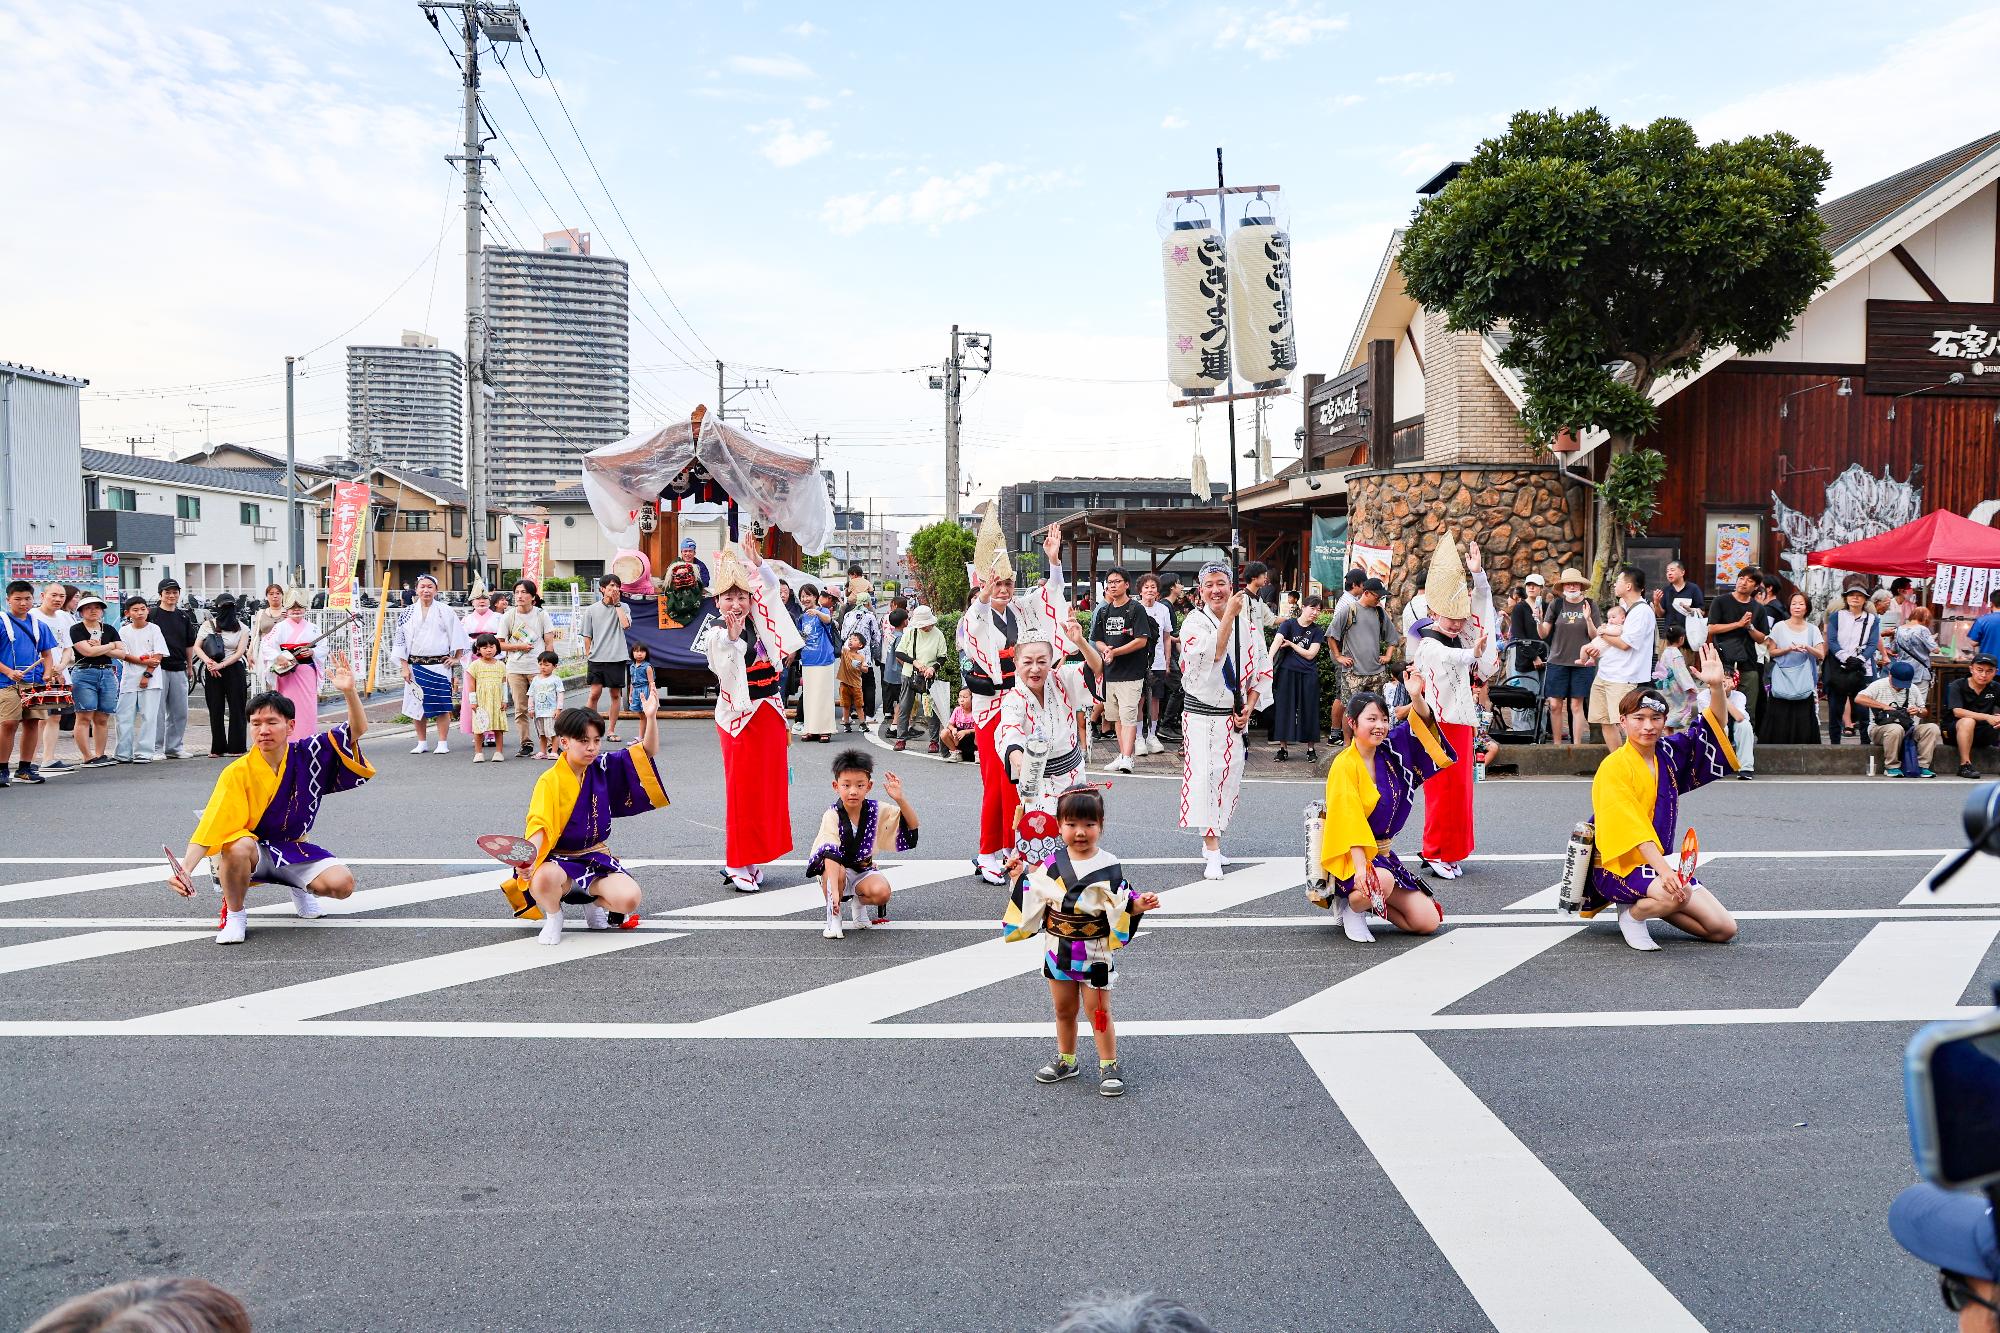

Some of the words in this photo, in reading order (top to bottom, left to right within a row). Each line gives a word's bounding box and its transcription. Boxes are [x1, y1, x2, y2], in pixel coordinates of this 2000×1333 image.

[1319, 385, 1359, 426] 石窯パン工房
[332, 501, 357, 593] キャンペーン
[527, 538, 540, 582] キャンペ
